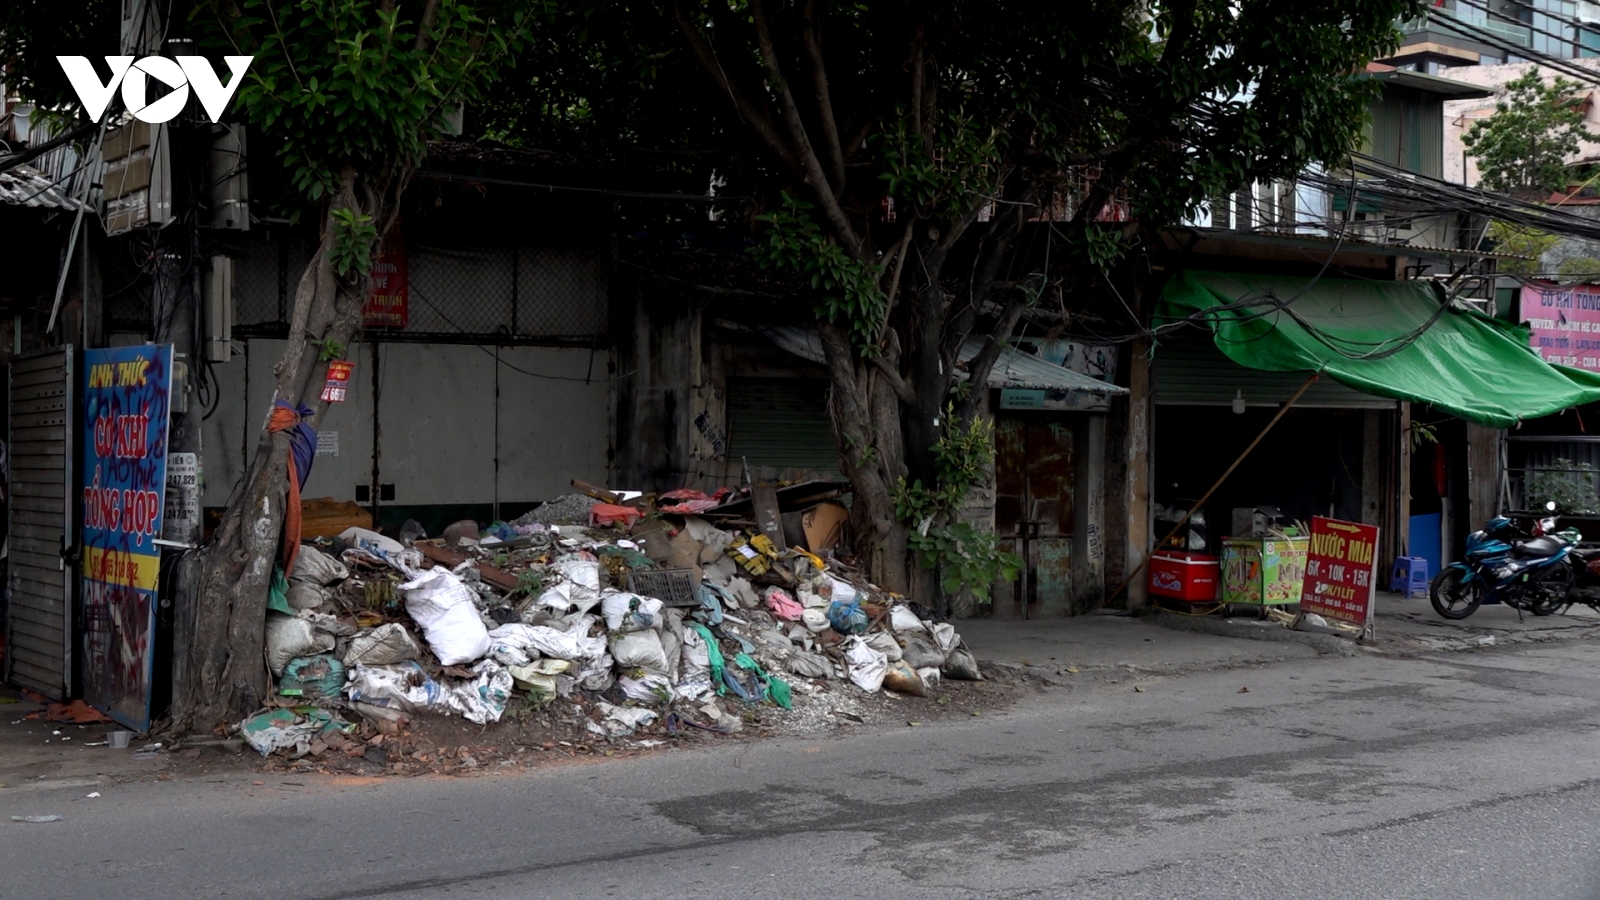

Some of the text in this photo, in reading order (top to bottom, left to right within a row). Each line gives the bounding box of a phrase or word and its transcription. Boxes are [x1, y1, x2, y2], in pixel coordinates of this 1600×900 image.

[88, 363, 115, 388] ANH
[116, 400, 149, 460] KHÍ
[84, 464, 159, 547] TỔNG HỢP
[1310, 531, 1373, 565] NƯỚC MÍA
[1307, 559, 1321, 577] 6K
[1328, 563, 1346, 582] 10K
[1353, 568, 1371, 587] 15K
